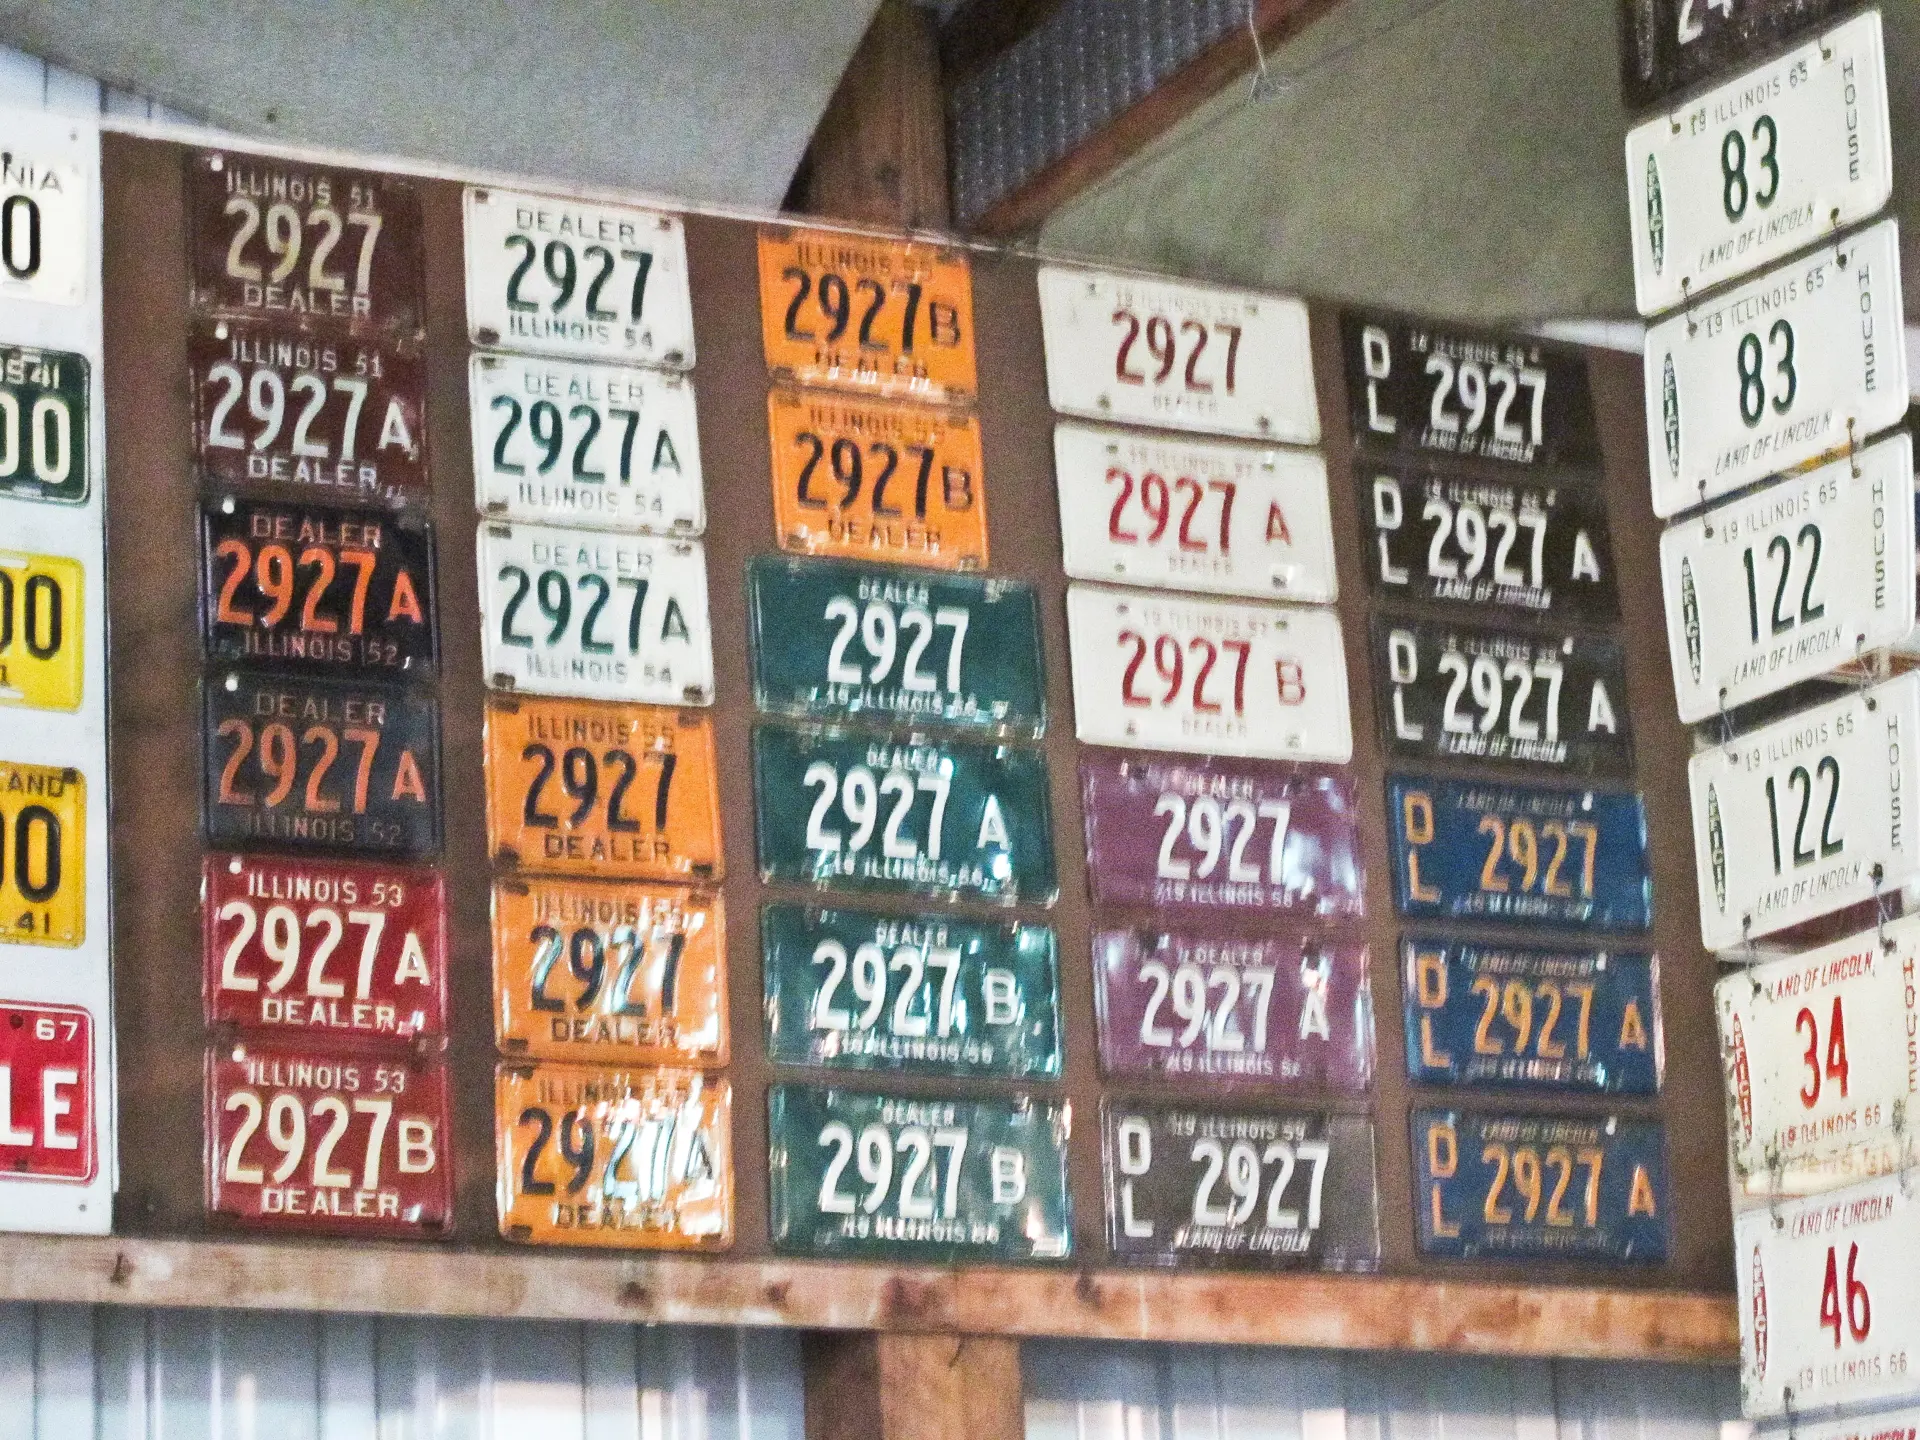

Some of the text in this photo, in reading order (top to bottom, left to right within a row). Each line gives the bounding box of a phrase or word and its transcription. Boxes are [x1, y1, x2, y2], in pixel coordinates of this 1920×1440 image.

[1714, 61, 1809, 124] ILLINOIS 65
[1842, 58, 1860, 182] HOUSE
[227, 171, 331, 204] ILLINOIS
[1721, 114, 1780, 223] 83
[2, 195, 41, 280] 0
[224, 199, 382, 300] 2927
[516, 208, 634, 245] DEALER
[1699, 202, 1814, 272] LAND OF LINCOLN
[244, 285, 370, 316] DEALER
[504, 235, 653, 325] 2927
[782, 266, 960, 355] 2927 B
[1706, 268, 1825, 338] 19 ILLINOIS 65
[232, 340, 336, 371] ILLINOIS
[510, 315, 653, 349] ILLINOIS 54
[1111, 308, 1242, 397] 2927
[1858, 265, 1876, 393] HOUSE
[525, 372, 643, 404] DEALER
[1426, 352, 1547, 446] 2927
[1737, 318, 1796, 429] 83
[209, 364, 411, 461] 2927 A
[490, 395, 682, 487] 2927 A
[1715, 411, 1833, 476] LAND OF LINCOLN
[248, 454, 376, 489] DEALER
[519, 483, 663, 517] ILLINOIS 54
[796, 432, 973, 519] 2927 B
[1450, 484, 1514, 509] ILLINOIS
[253, 515, 381, 547] DEALER
[828, 519, 940, 547] DEALER
[1105, 466, 1292, 556] 2927 A
[1723, 479, 1838, 544] 19 ILLINOIS 65
[533, 542, 652, 573] DEALER
[1422, 500, 1600, 588] 2927 A
[1872, 479, 1885, 609] HOUSE
[217, 539, 423, 634] 2927 A
[499, 565, 690, 655] 2927 A
[859, 577, 929, 605] DEALER
[1436, 578, 1471, 600] LAND
[1744, 523, 1825, 646] 122
[245, 632, 397, 665] ILLINOIS 52
[527, 654, 627, 685] ILLINOIS
[824, 594, 969, 693] 2927
[1117, 628, 1306, 717] 2927 B
[1465, 637, 1531, 661] ILLINOIS
[1733, 624, 1842, 686] LAND OF LINCOLN
[256, 692, 384, 725] DEALER
[860, 688, 943, 716] ILLINOIS
[1438, 650, 1616, 741] 2927 A
[528, 715, 629, 745] ILLINOIS
[867, 743, 937, 771] DEALER
[1450, 733, 1568, 763] LAND OF LINCOLN
[1745, 713, 1854, 772] 19 ILLINOIS 65
[9, 773, 64, 799] AND
[218, 719, 426, 813] 2927 A
[522, 743, 677, 832] 2927
[1887, 715, 1901, 848] HOUSE
[803, 761, 1012, 861] 2927 A
[1153, 792, 1291, 885] 2927
[1765, 755, 1844, 877] 122
[544, 834, 670, 862] DEALER
[865, 855, 950, 885] ILLINOIS
[1478, 815, 1597, 897] 2927
[249, 874, 402, 907] ILLINOIS 53
[534, 896, 636, 926] ILLINOIS
[1191, 882, 1264, 907] ILLINOIS
[1757, 861, 1862, 917] LAND OF LINCOLN
[15, 911, 49, 935] 41
[220, 901, 431, 1000] 2927 A
[876, 922, 948, 948] DEALER
[530, 926, 685, 1016] 2927
[1196, 945, 1263, 967] DEALER
[1770, 951, 1873, 1003] LAND OF LINCOLN
[263, 999, 395, 1030] DEALER
[812, 938, 1018, 1038] 2927 B
[1139, 960, 1329, 1052] 2927 A
[1471, 976, 1646, 1060] 2927 A
[36, 1020, 77, 1042] 67
[551, 1016, 677, 1048] DEALER
[873, 1034, 960, 1063] ILLINOIS
[1796, 995, 1849, 1110] 34
[1902, 956, 1918, 1094] HOUSE
[249, 1062, 405, 1093] ILLINOIS 53
[1200, 1052, 1273, 1076] ILLINOIS
[0, 1068, 78, 1149] LE
[883, 1100, 955, 1127] DEALER
[1201, 1117, 1276, 1140] ILLINOIS
[1864, 1104, 1881, 1127] 66
[225, 1092, 435, 1190] 2927 B
[519, 1108, 713, 1207] 2927 A
[818, 1121, 1026, 1219] 2927 B
[262, 1188, 399, 1217] DEALER
[1191, 1138, 1329, 1230] 2927
[1482, 1144, 1655, 1228] 2927 A
[876, 1216, 965, 1243] ILLINOIS
[1249, 1227, 1311, 1253] LINCOLN
[1791, 1193, 1894, 1240] LAND OF LINCOLN
[1819, 1240, 1871, 1350] 46
[1799, 1351, 1907, 1390] 19 ILLINOIS 66
